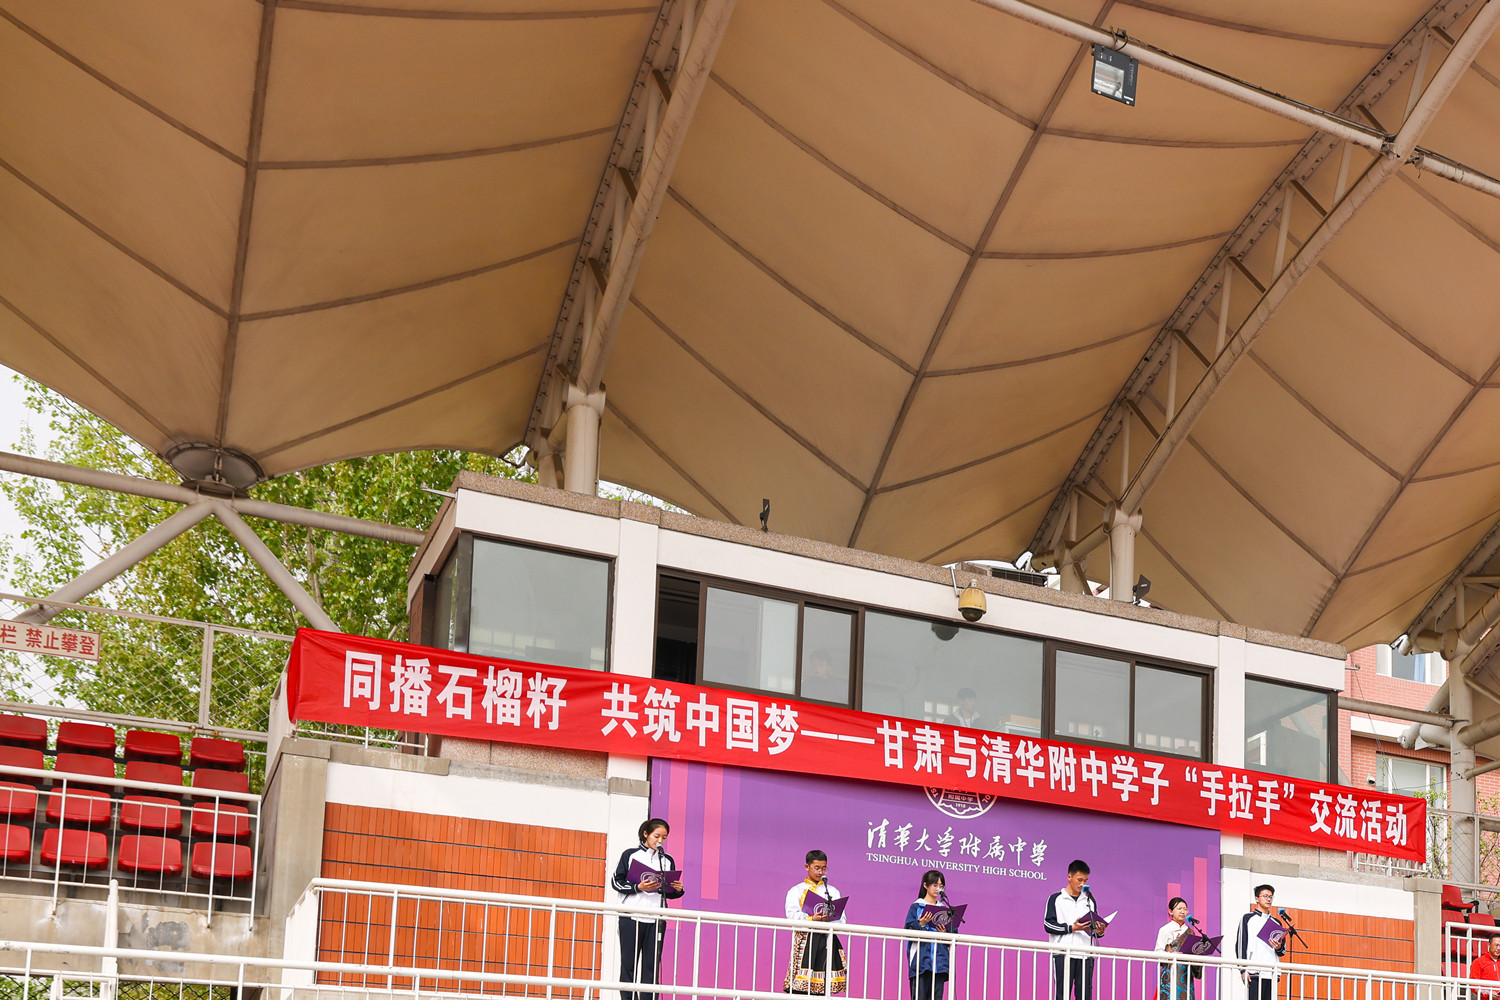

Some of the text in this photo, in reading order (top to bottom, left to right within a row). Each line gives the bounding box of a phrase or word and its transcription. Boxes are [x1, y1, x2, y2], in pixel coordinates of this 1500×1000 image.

[26, 628, 95, 656] 禁止攀登
[343, 650, 567, 731] 同播石榴籽
[866, 853, 1047, 880] TSINGHUA UNIVERSITY HIGH SCHOOL
